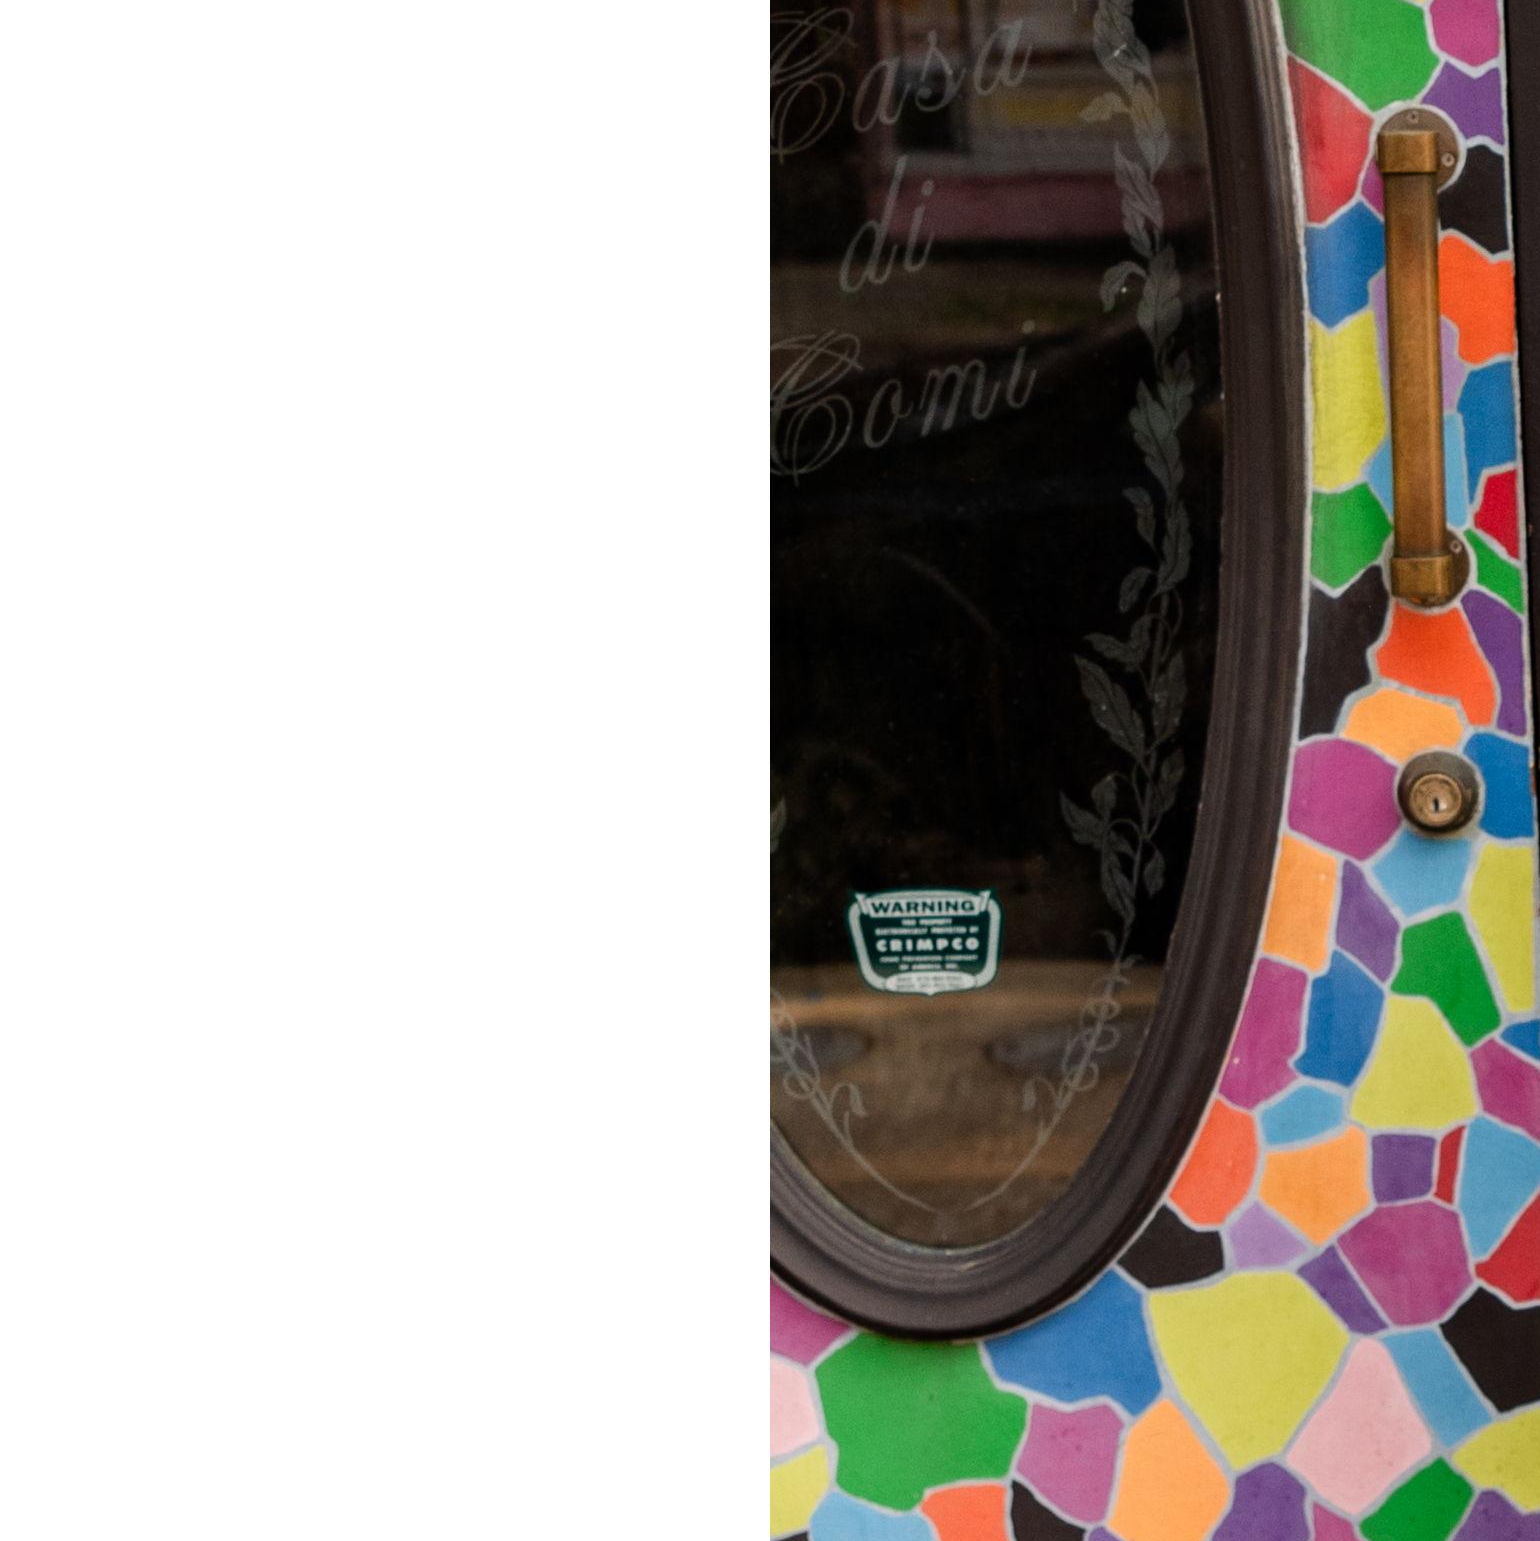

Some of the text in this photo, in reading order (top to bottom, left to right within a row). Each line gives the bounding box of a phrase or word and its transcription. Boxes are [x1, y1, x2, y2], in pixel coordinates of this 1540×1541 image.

[770, 7, 1034, 162] Casa
[839, 155, 936, 293] di
[871, 900, 975, 914] WARNING
[876, 937, 979, 952] CRIMPCO
